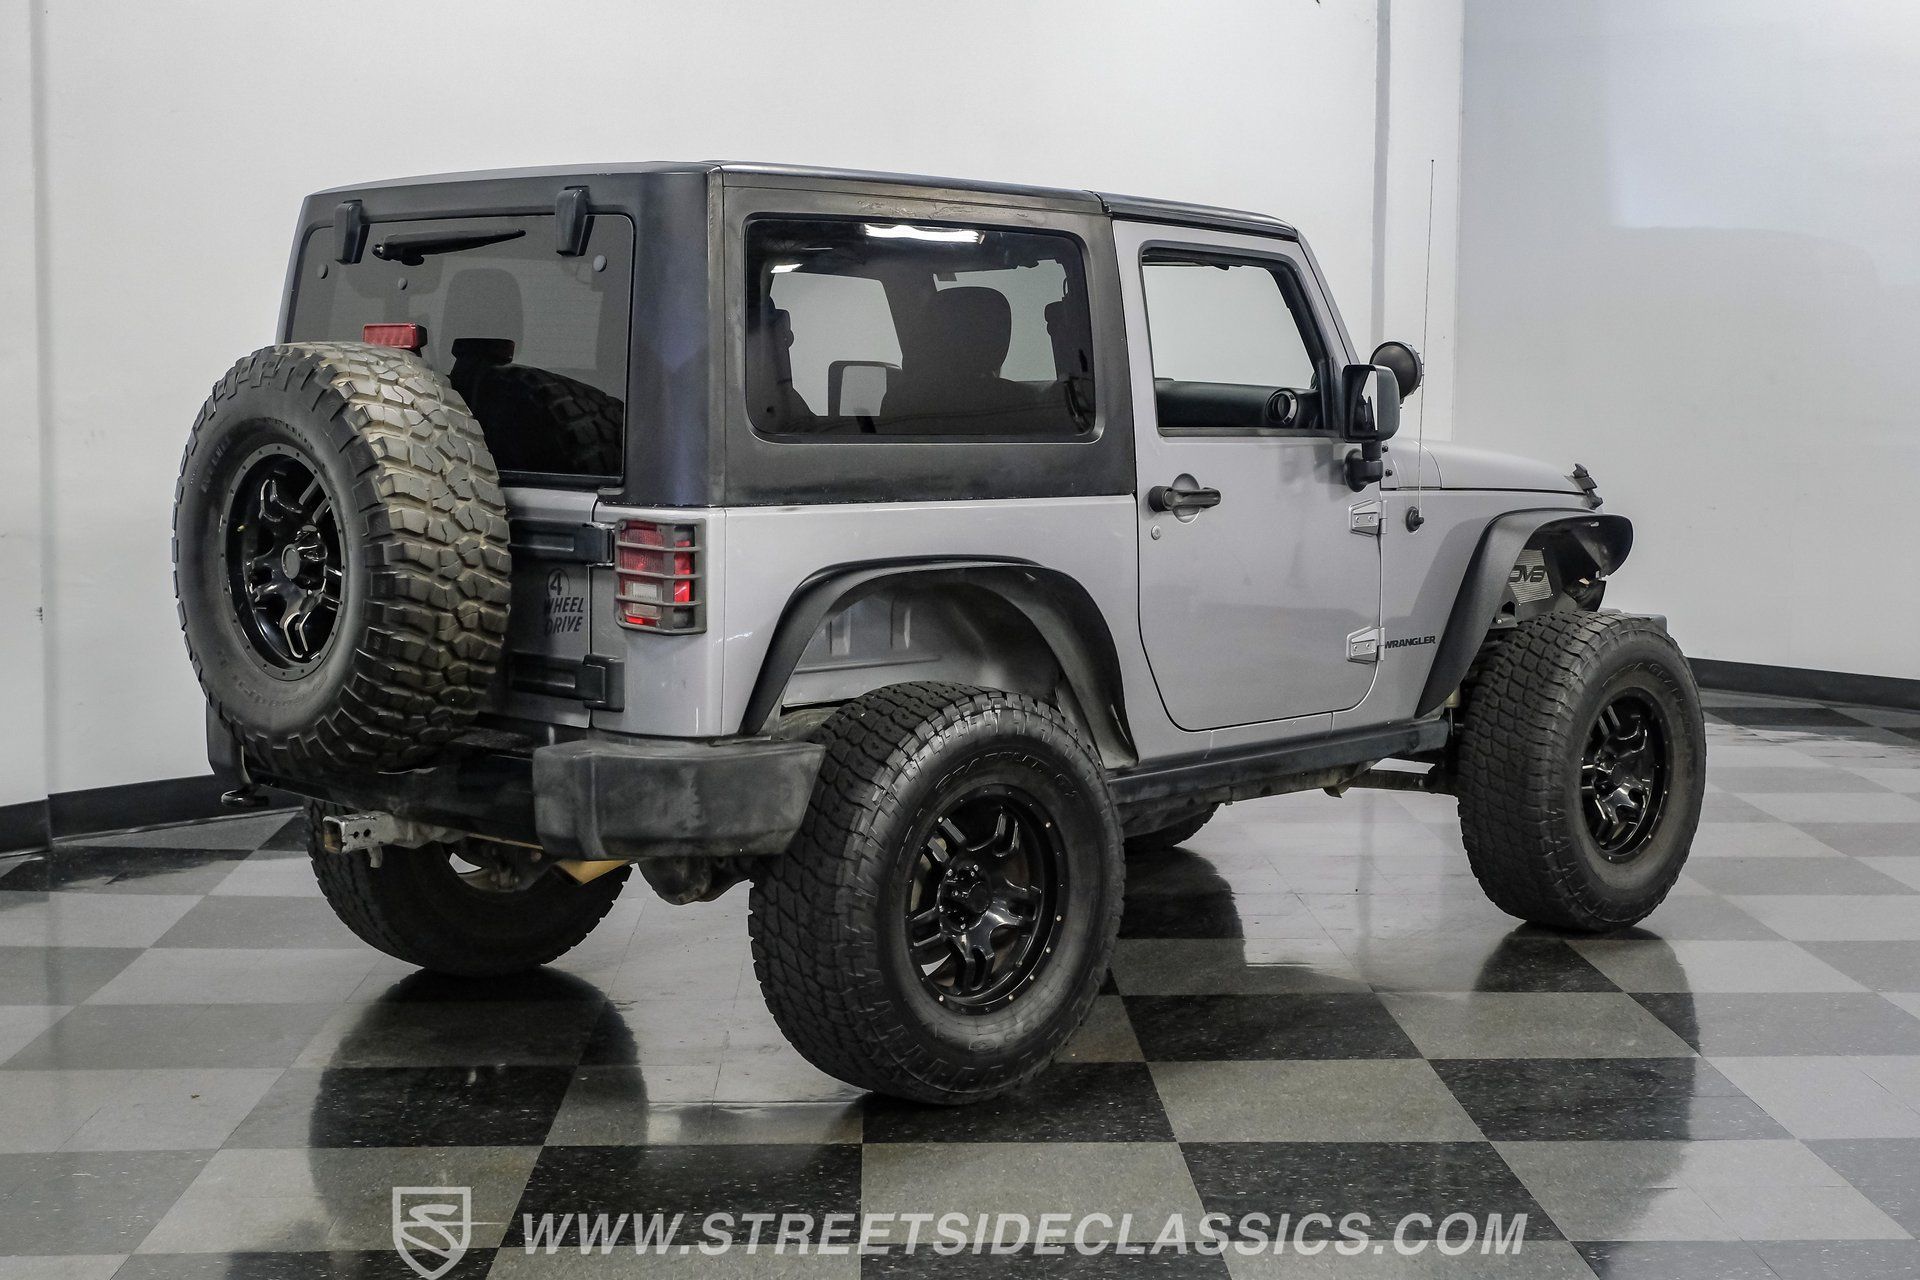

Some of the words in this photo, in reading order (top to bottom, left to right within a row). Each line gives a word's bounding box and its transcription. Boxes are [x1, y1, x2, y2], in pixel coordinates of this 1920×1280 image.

[544, 597, 585, 615] WHEEL
[544, 616, 583, 636] DRIVE
[1384, 635, 1436, 649] WRANGLER
